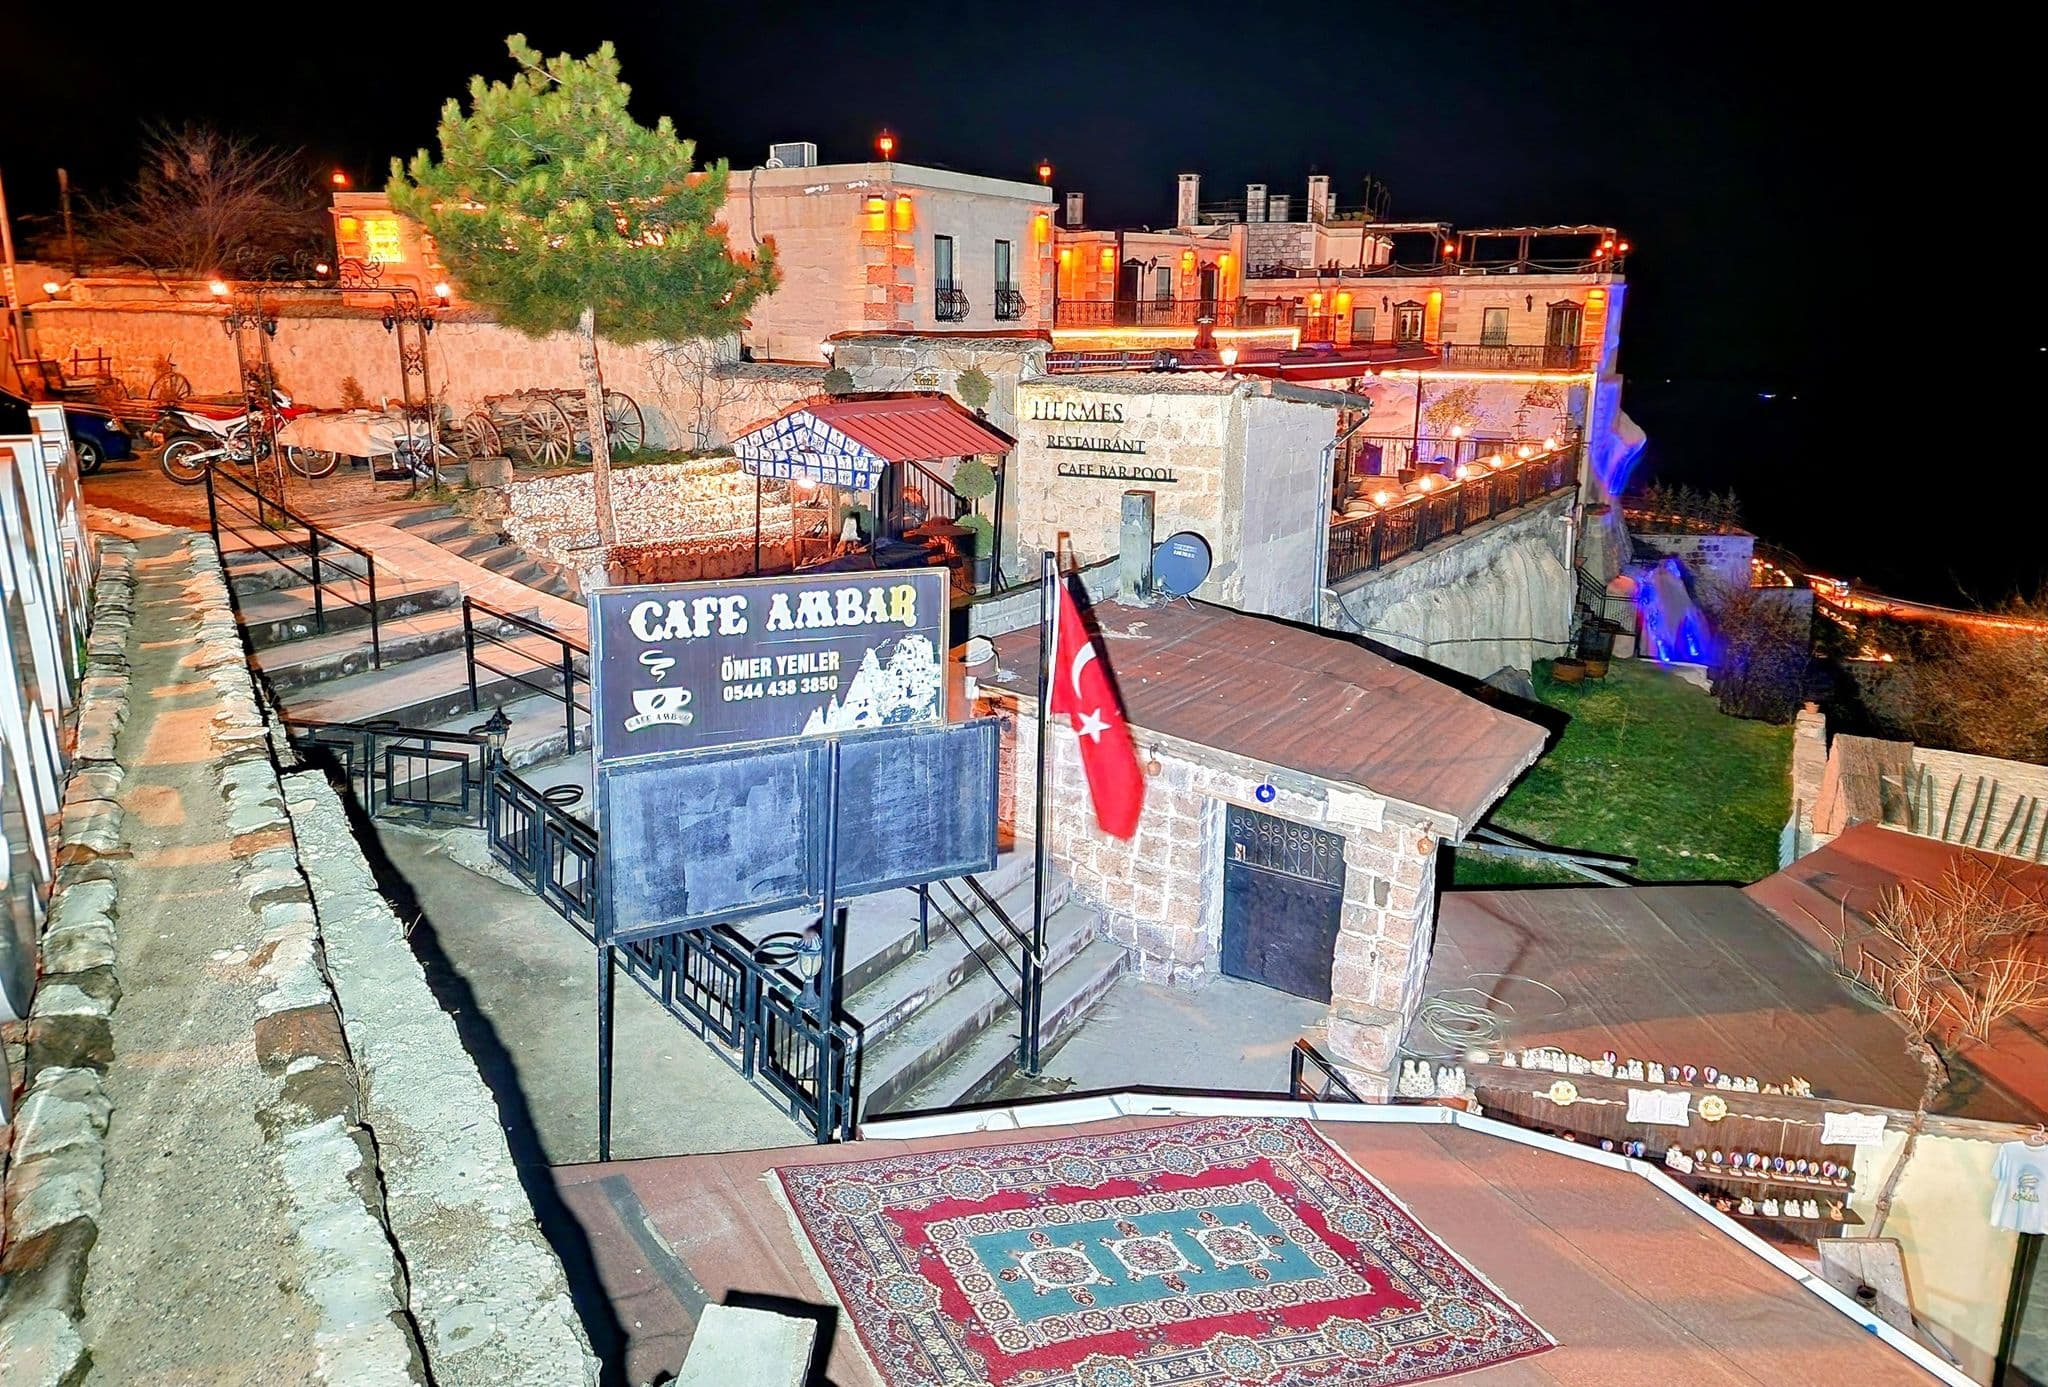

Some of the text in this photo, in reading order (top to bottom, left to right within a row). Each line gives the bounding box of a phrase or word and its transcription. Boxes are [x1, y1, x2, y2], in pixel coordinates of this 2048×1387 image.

[1032, 401, 1124, 423] HERMES
[1046, 435, 1146, 454] RESTAURANT
[1057, 462, 1177, 482] CAFE BAR POOL
[629, 584, 917, 642] CAFE AMBAR
[721, 651, 840, 682] ÖMER YENLER
[723, 675, 838, 702] 0544 438 3850
